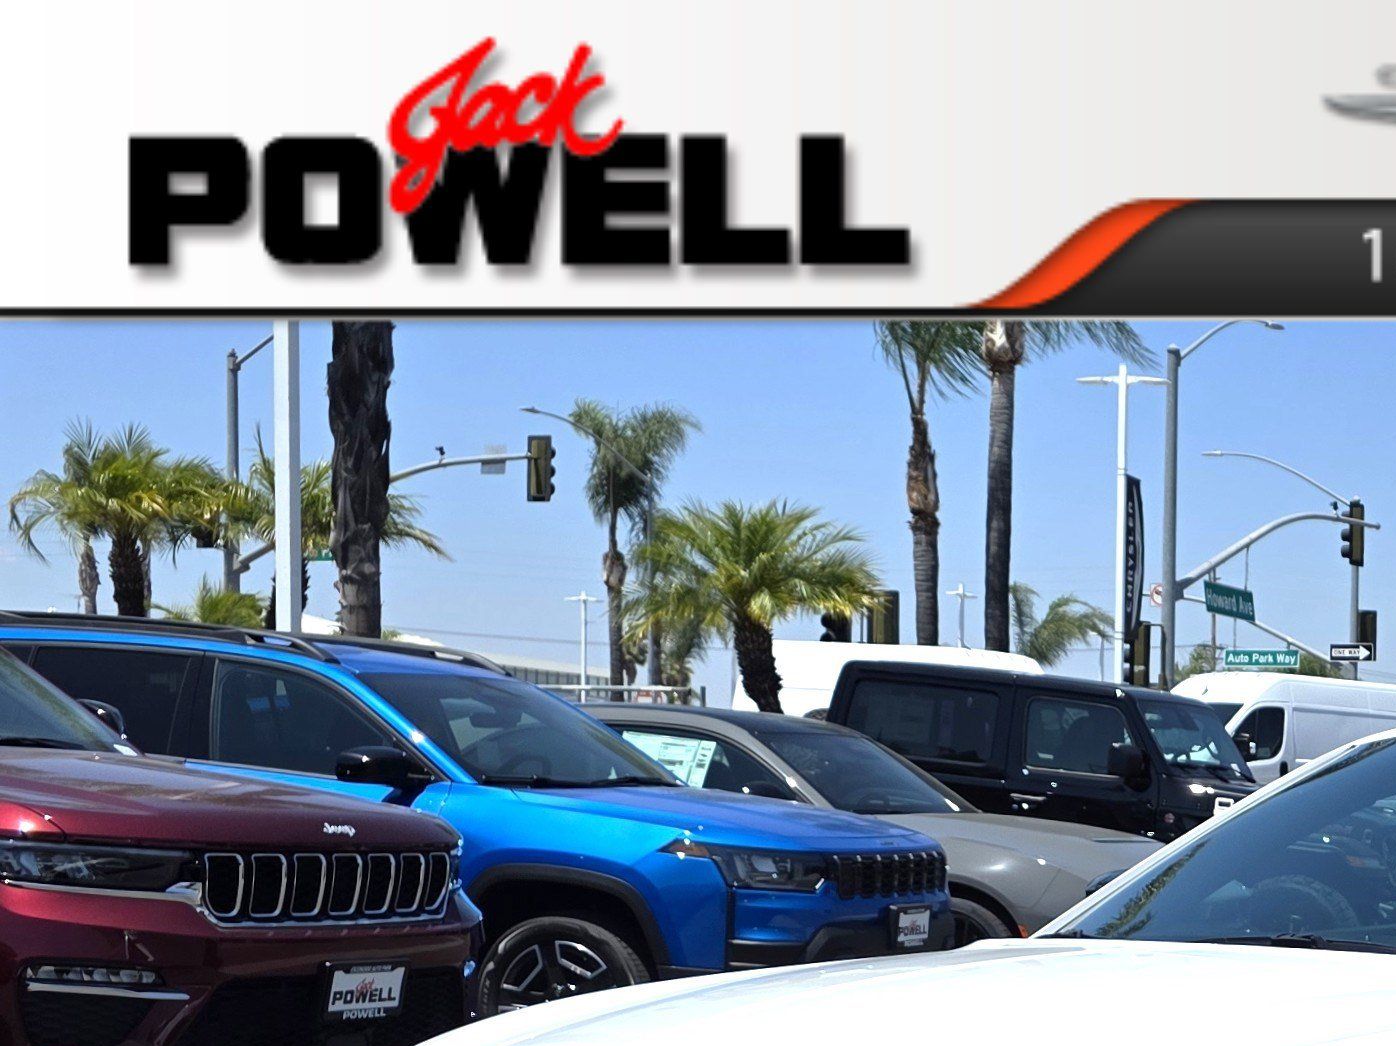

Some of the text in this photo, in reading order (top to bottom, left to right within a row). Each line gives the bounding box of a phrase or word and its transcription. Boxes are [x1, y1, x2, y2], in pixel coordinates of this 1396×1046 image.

[1207, 589, 1254, 616] Howard Ave
[1227, 652, 1297, 667] Auto Park Way
[332, 987, 396, 1005] POWELL
[343, 1007, 386, 1019] POWELL
